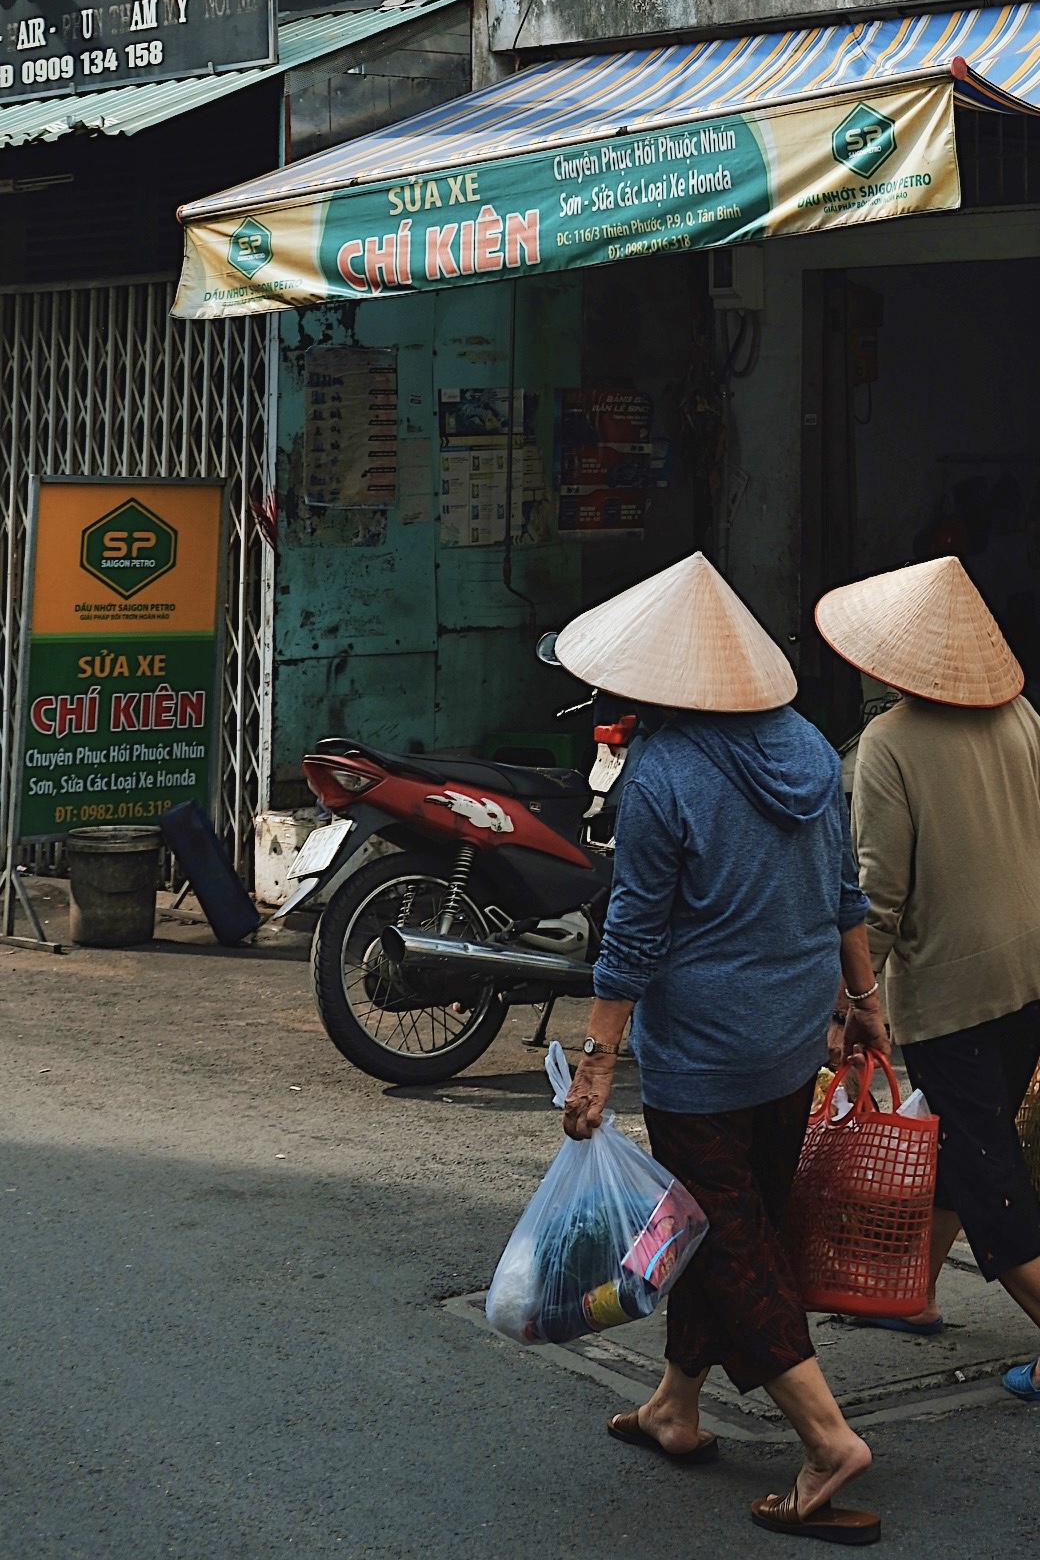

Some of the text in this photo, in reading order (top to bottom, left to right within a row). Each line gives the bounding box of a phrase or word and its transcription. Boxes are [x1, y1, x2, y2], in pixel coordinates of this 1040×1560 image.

[21, 55, 74, 84] 0909
[80, 48, 118, 75] 134
[125, 40, 163, 68] 158
[553, 151, 599, 184] Chuyên
[601, 145, 633, 176] Phục
[658, 132, 698, 164] Phuộc
[700, 125, 736, 155] Nhún
[387, 172, 480, 216] SỬA XE
[559, 192, 582, 217] Sơn
[592, 183, 615, 212] Sửa
[617, 179, 639, 207] Các
[641, 174, 667, 208] Loại
[669, 172, 685, 199] Xe
[688, 164, 732, 195] Honda
[557, 232, 573, 247] ĐC:
[573, 227, 600, 244] 116/3
[602, 221, 629, 238] Thiên
[666, 214, 683, 229] P.9,
[685, 211, 695, 226] Q.
[697, 208, 715, 223] Tân
[717, 203, 741, 220] Bình
[337, 204, 541, 295] CHÍ KIÊN
[102, 531, 157, 558] SP
[118, 603, 149, 612] SAIGON
[150, 603, 176, 612] PETRO
[77, 649, 166, 678] SỬA XE
[31, 683, 206, 739] CHÍ KIÊN
[25, 748, 73, 770] Chuyên
[76, 746, 106, 768] Phục
[133, 743, 170, 764] Phuộc
[173, 741, 205, 759] Nhún
[28, 768, 196, 796] Sơn, Sửa Các Loại Xe Honda
[55, 806, 77, 823] ĐT:
